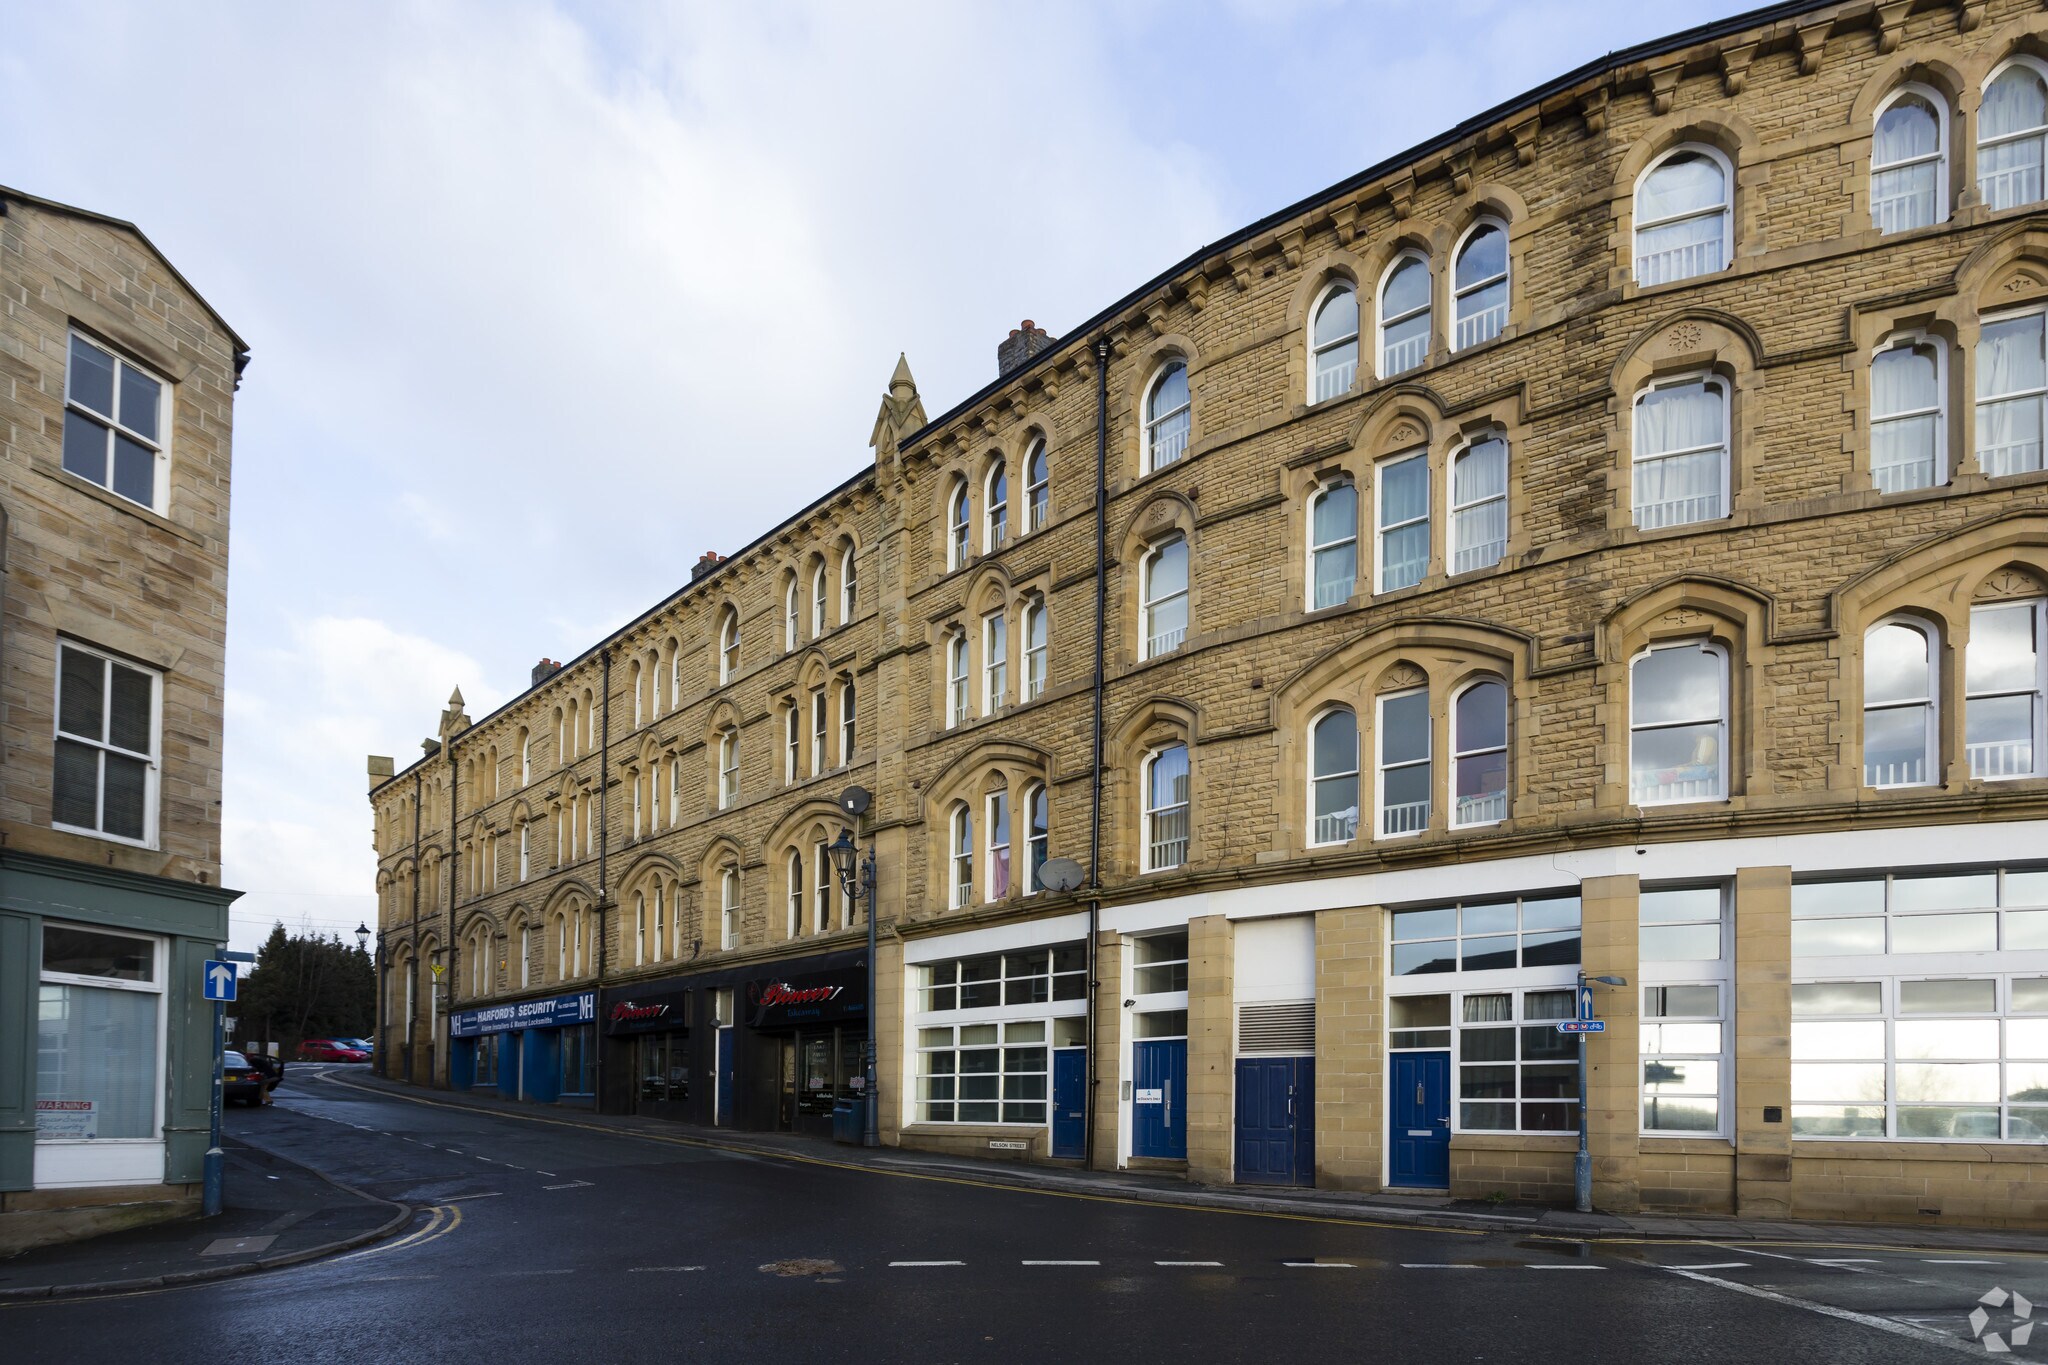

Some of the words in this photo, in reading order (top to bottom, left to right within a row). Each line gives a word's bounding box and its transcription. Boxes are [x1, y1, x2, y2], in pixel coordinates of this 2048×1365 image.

[477, 1006, 515, 1023] HARFORD'S
[518, 1000, 557, 1017] SECURITY
[528, 1017, 553, 1026] Locksmiths
[36, 1101, 90, 1110] WARNING
[36, 1123, 86, 1132] Security
